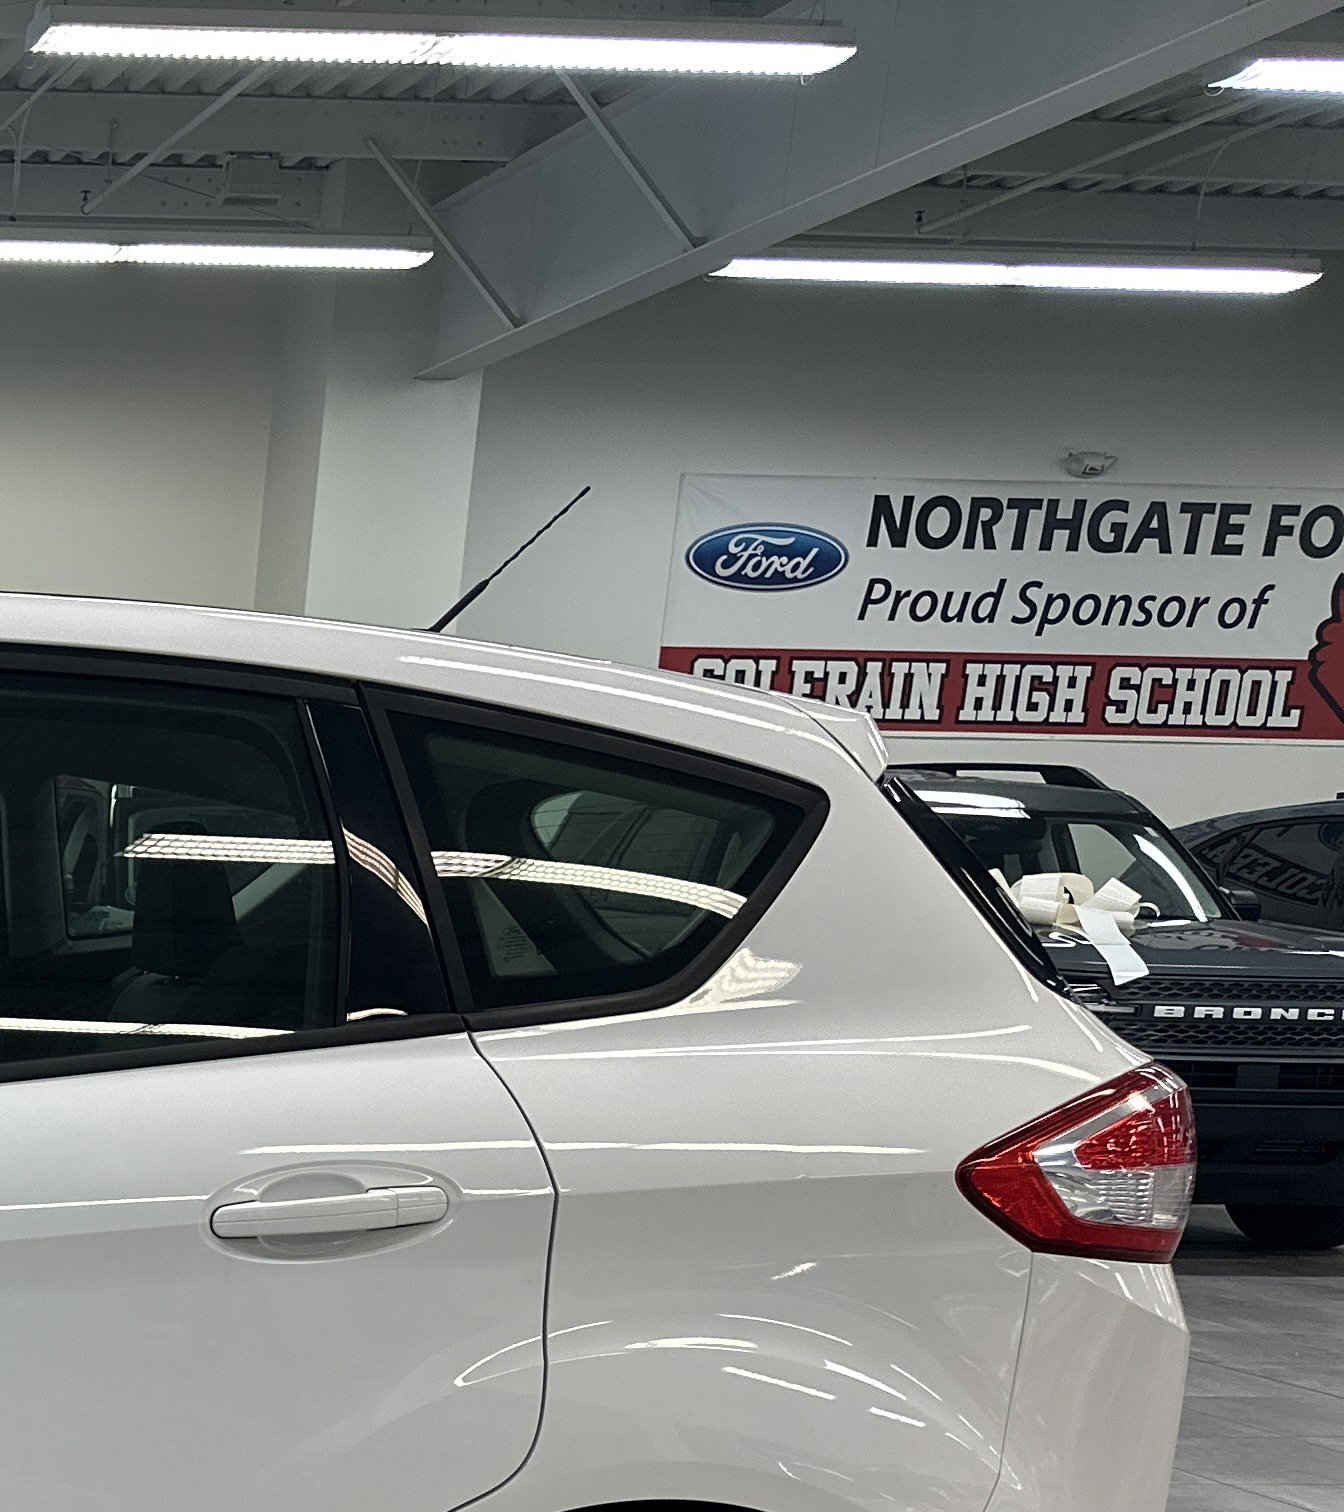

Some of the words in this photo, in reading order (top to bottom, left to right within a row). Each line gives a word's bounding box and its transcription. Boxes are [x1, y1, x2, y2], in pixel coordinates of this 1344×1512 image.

[865, 494, 1253, 556] NORTHGATE
[714, 533, 820, 580] Ford
[857, 577, 1008, 624] Proud
[1010, 580, 1209, 637] Sponsor
[1217, 583, 1276, 630] of
[958, 663, 1092, 724] HIGH
[1104, 666, 1301, 728] SCHOOL
[1153, 1005, 1344, 1021] BRONC
